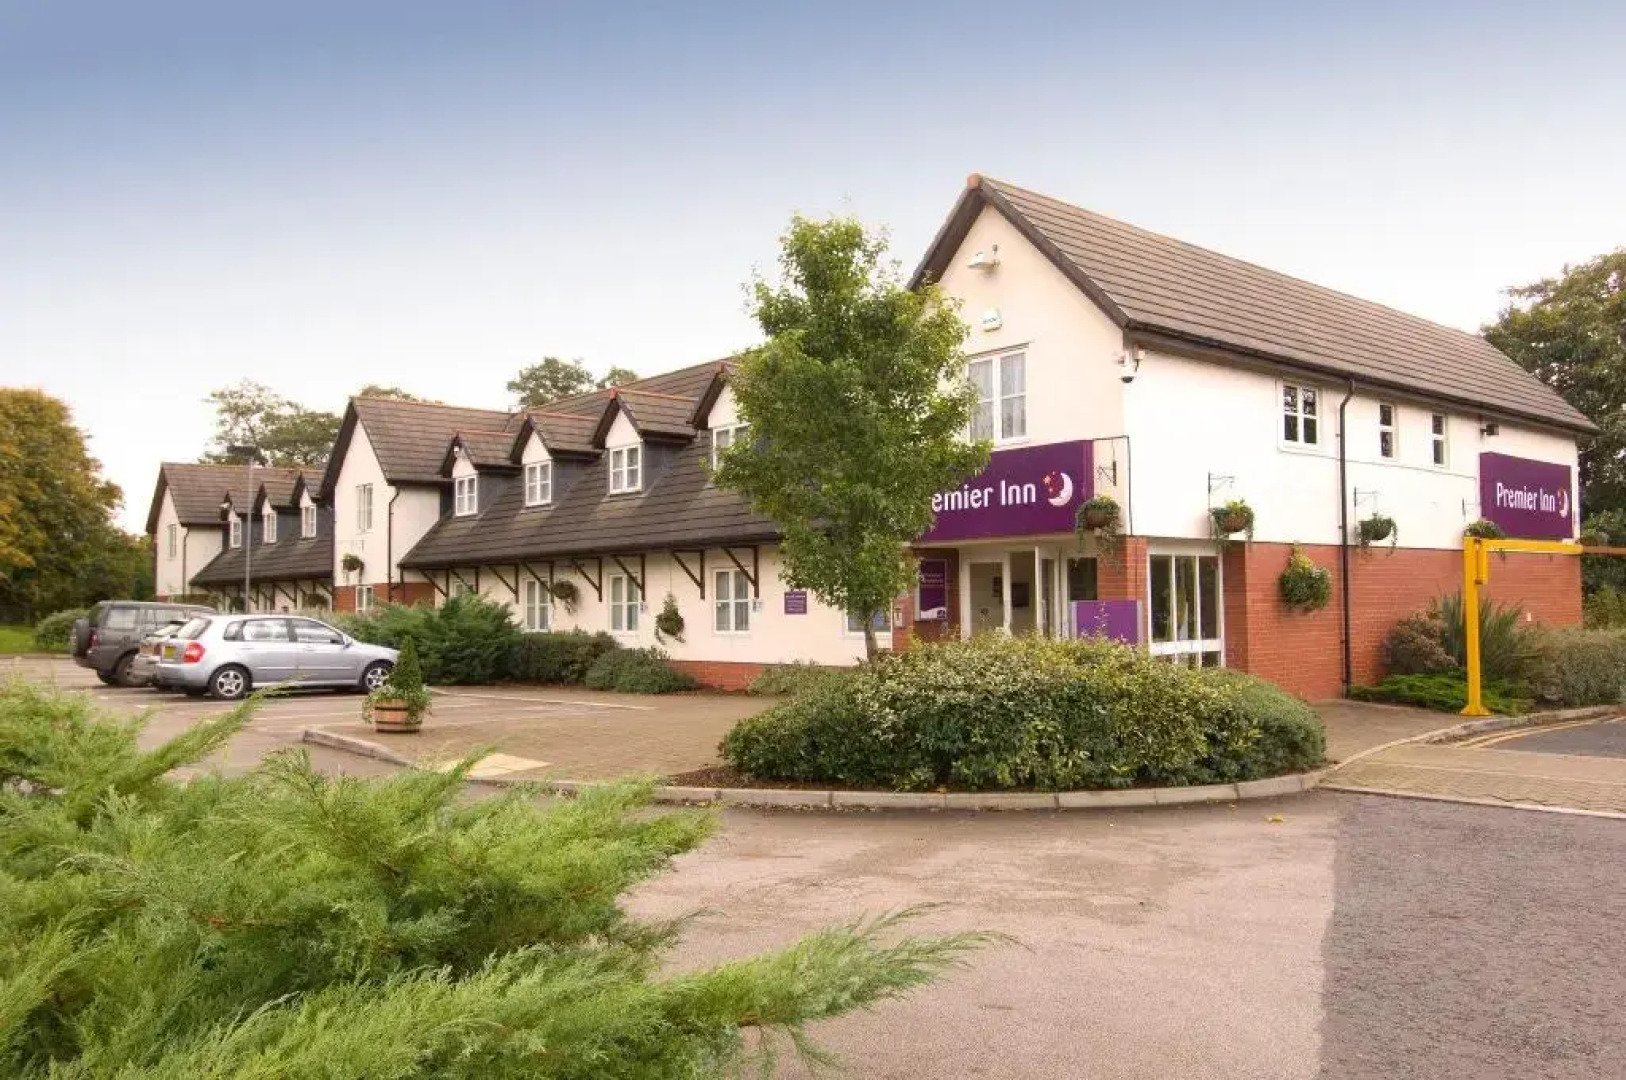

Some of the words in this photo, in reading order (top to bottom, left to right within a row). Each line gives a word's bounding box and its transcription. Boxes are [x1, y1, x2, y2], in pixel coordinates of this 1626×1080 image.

[931, 484, 994, 512] emier
[1000, 480, 1037, 506] Inn
[1496, 482, 1537, 511] Premier
[1539, 488, 1555, 512] Inn
